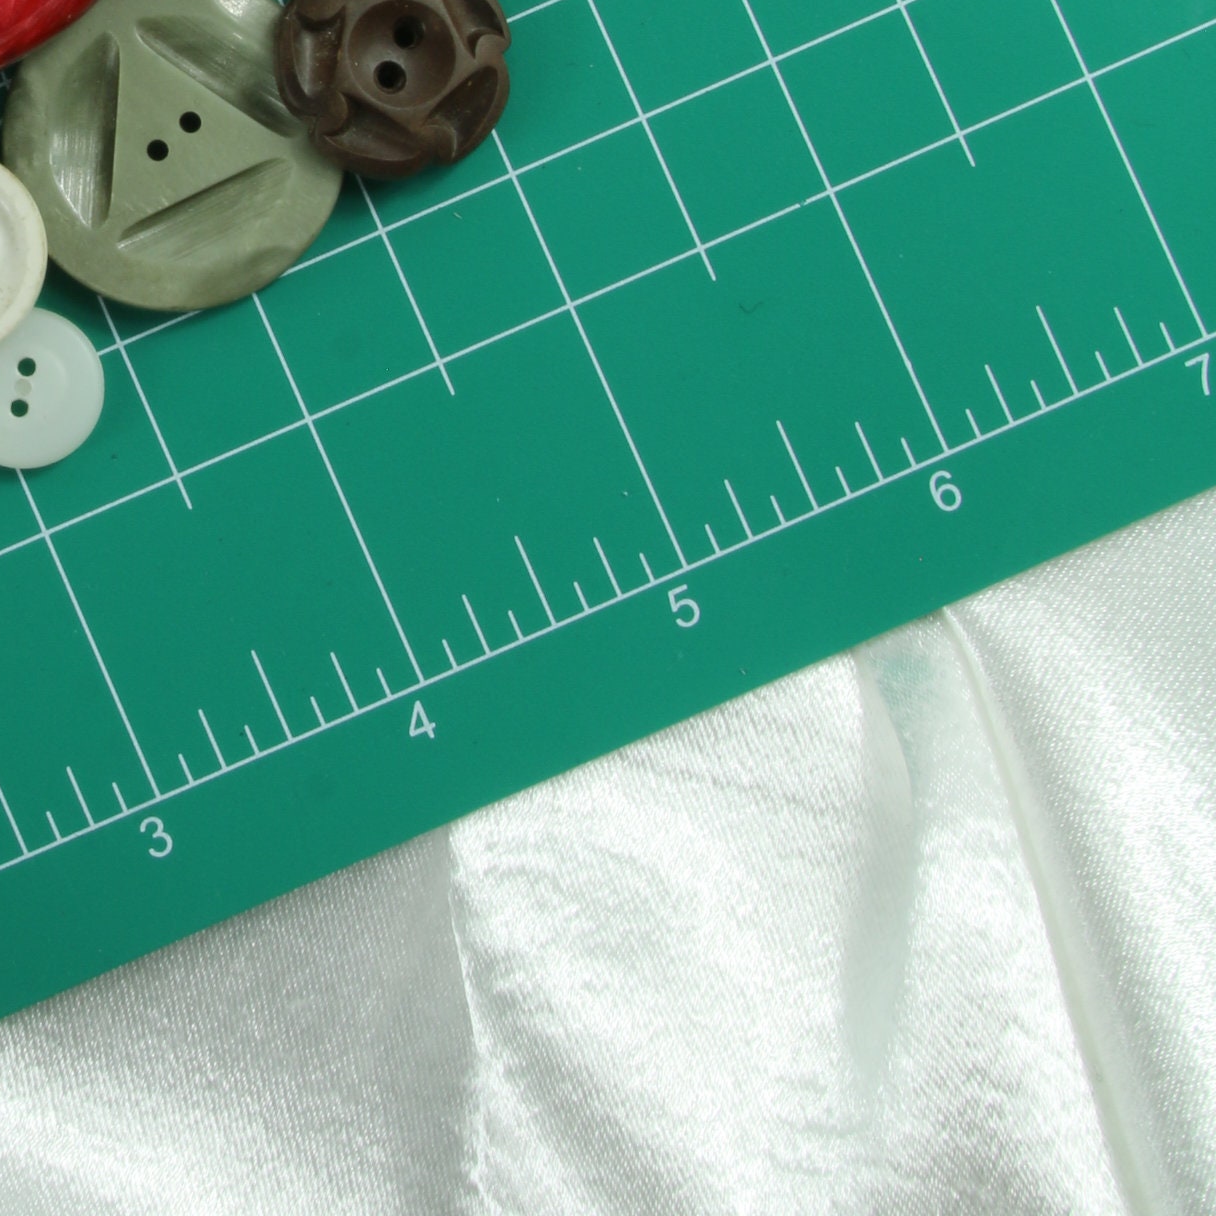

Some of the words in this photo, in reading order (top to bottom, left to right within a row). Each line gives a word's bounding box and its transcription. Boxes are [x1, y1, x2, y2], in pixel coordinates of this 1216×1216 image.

[1184, 351, 1211, 397] 7
[928, 469, 963, 513] 6
[667, 583, 701, 629] 5
[408, 699, 437, 740] 4
[139, 815, 174, 859] 3
